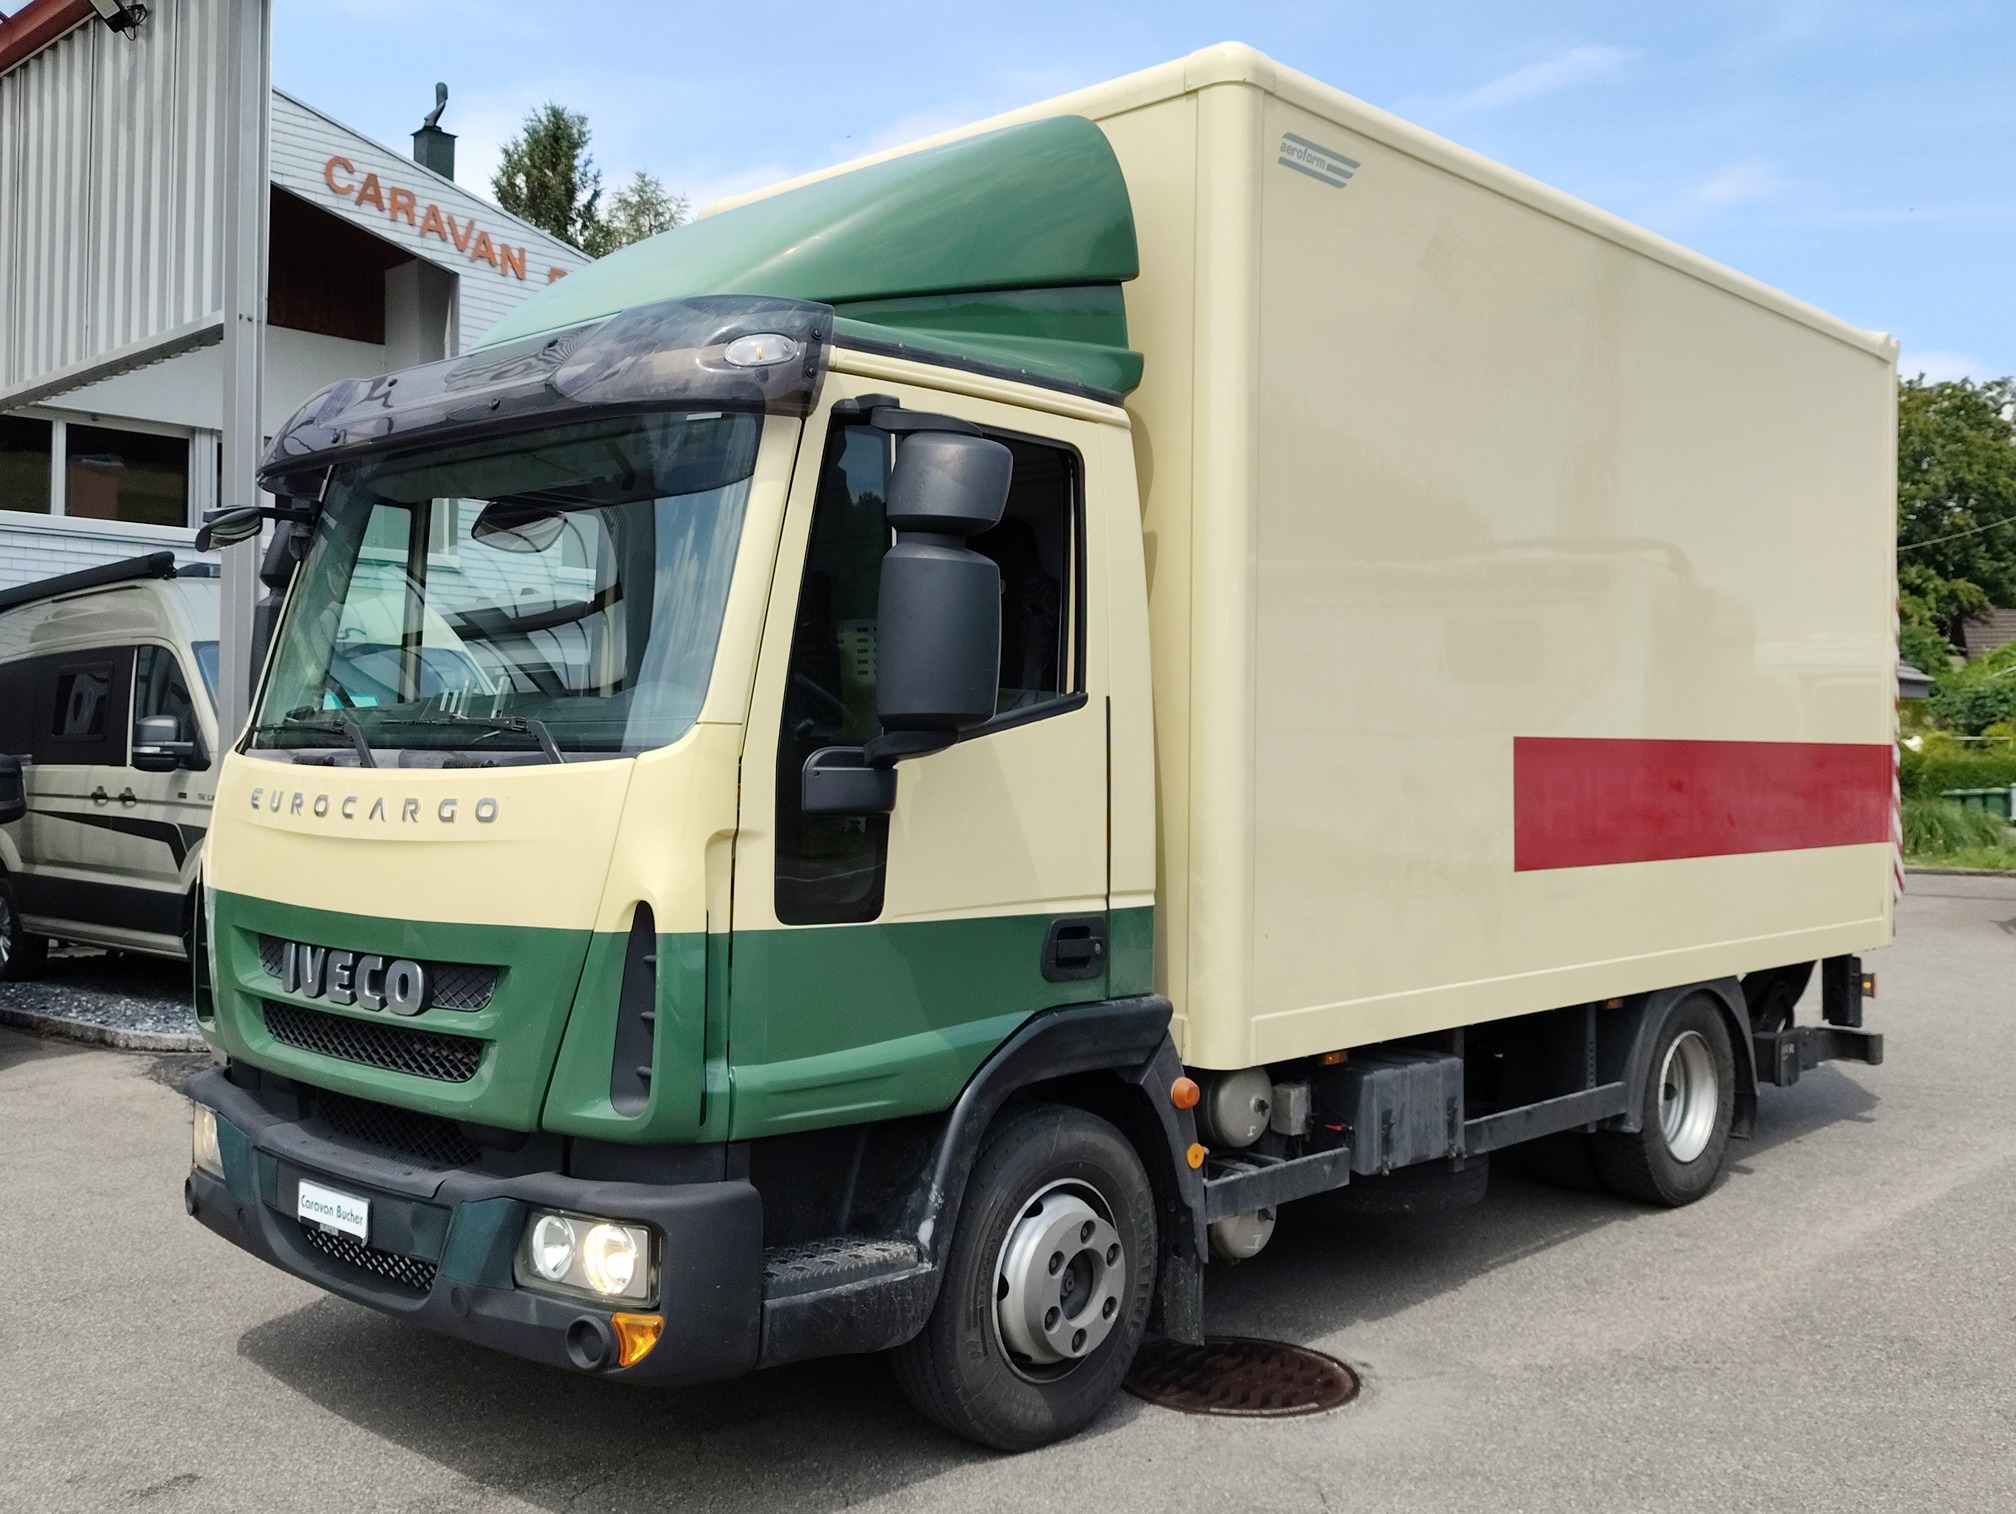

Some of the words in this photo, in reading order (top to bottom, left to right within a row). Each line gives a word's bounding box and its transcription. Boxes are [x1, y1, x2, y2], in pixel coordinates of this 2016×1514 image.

[1280, 141, 1326, 170] aeroform
[324, 156, 527, 281] CARAVAN
[250, 787, 500, 824] EUROCARGO
[281, 942, 426, 1017] IVECO
[301, 1194, 334, 1217] Caravan
[336, 1205, 364, 1227] Bucher
